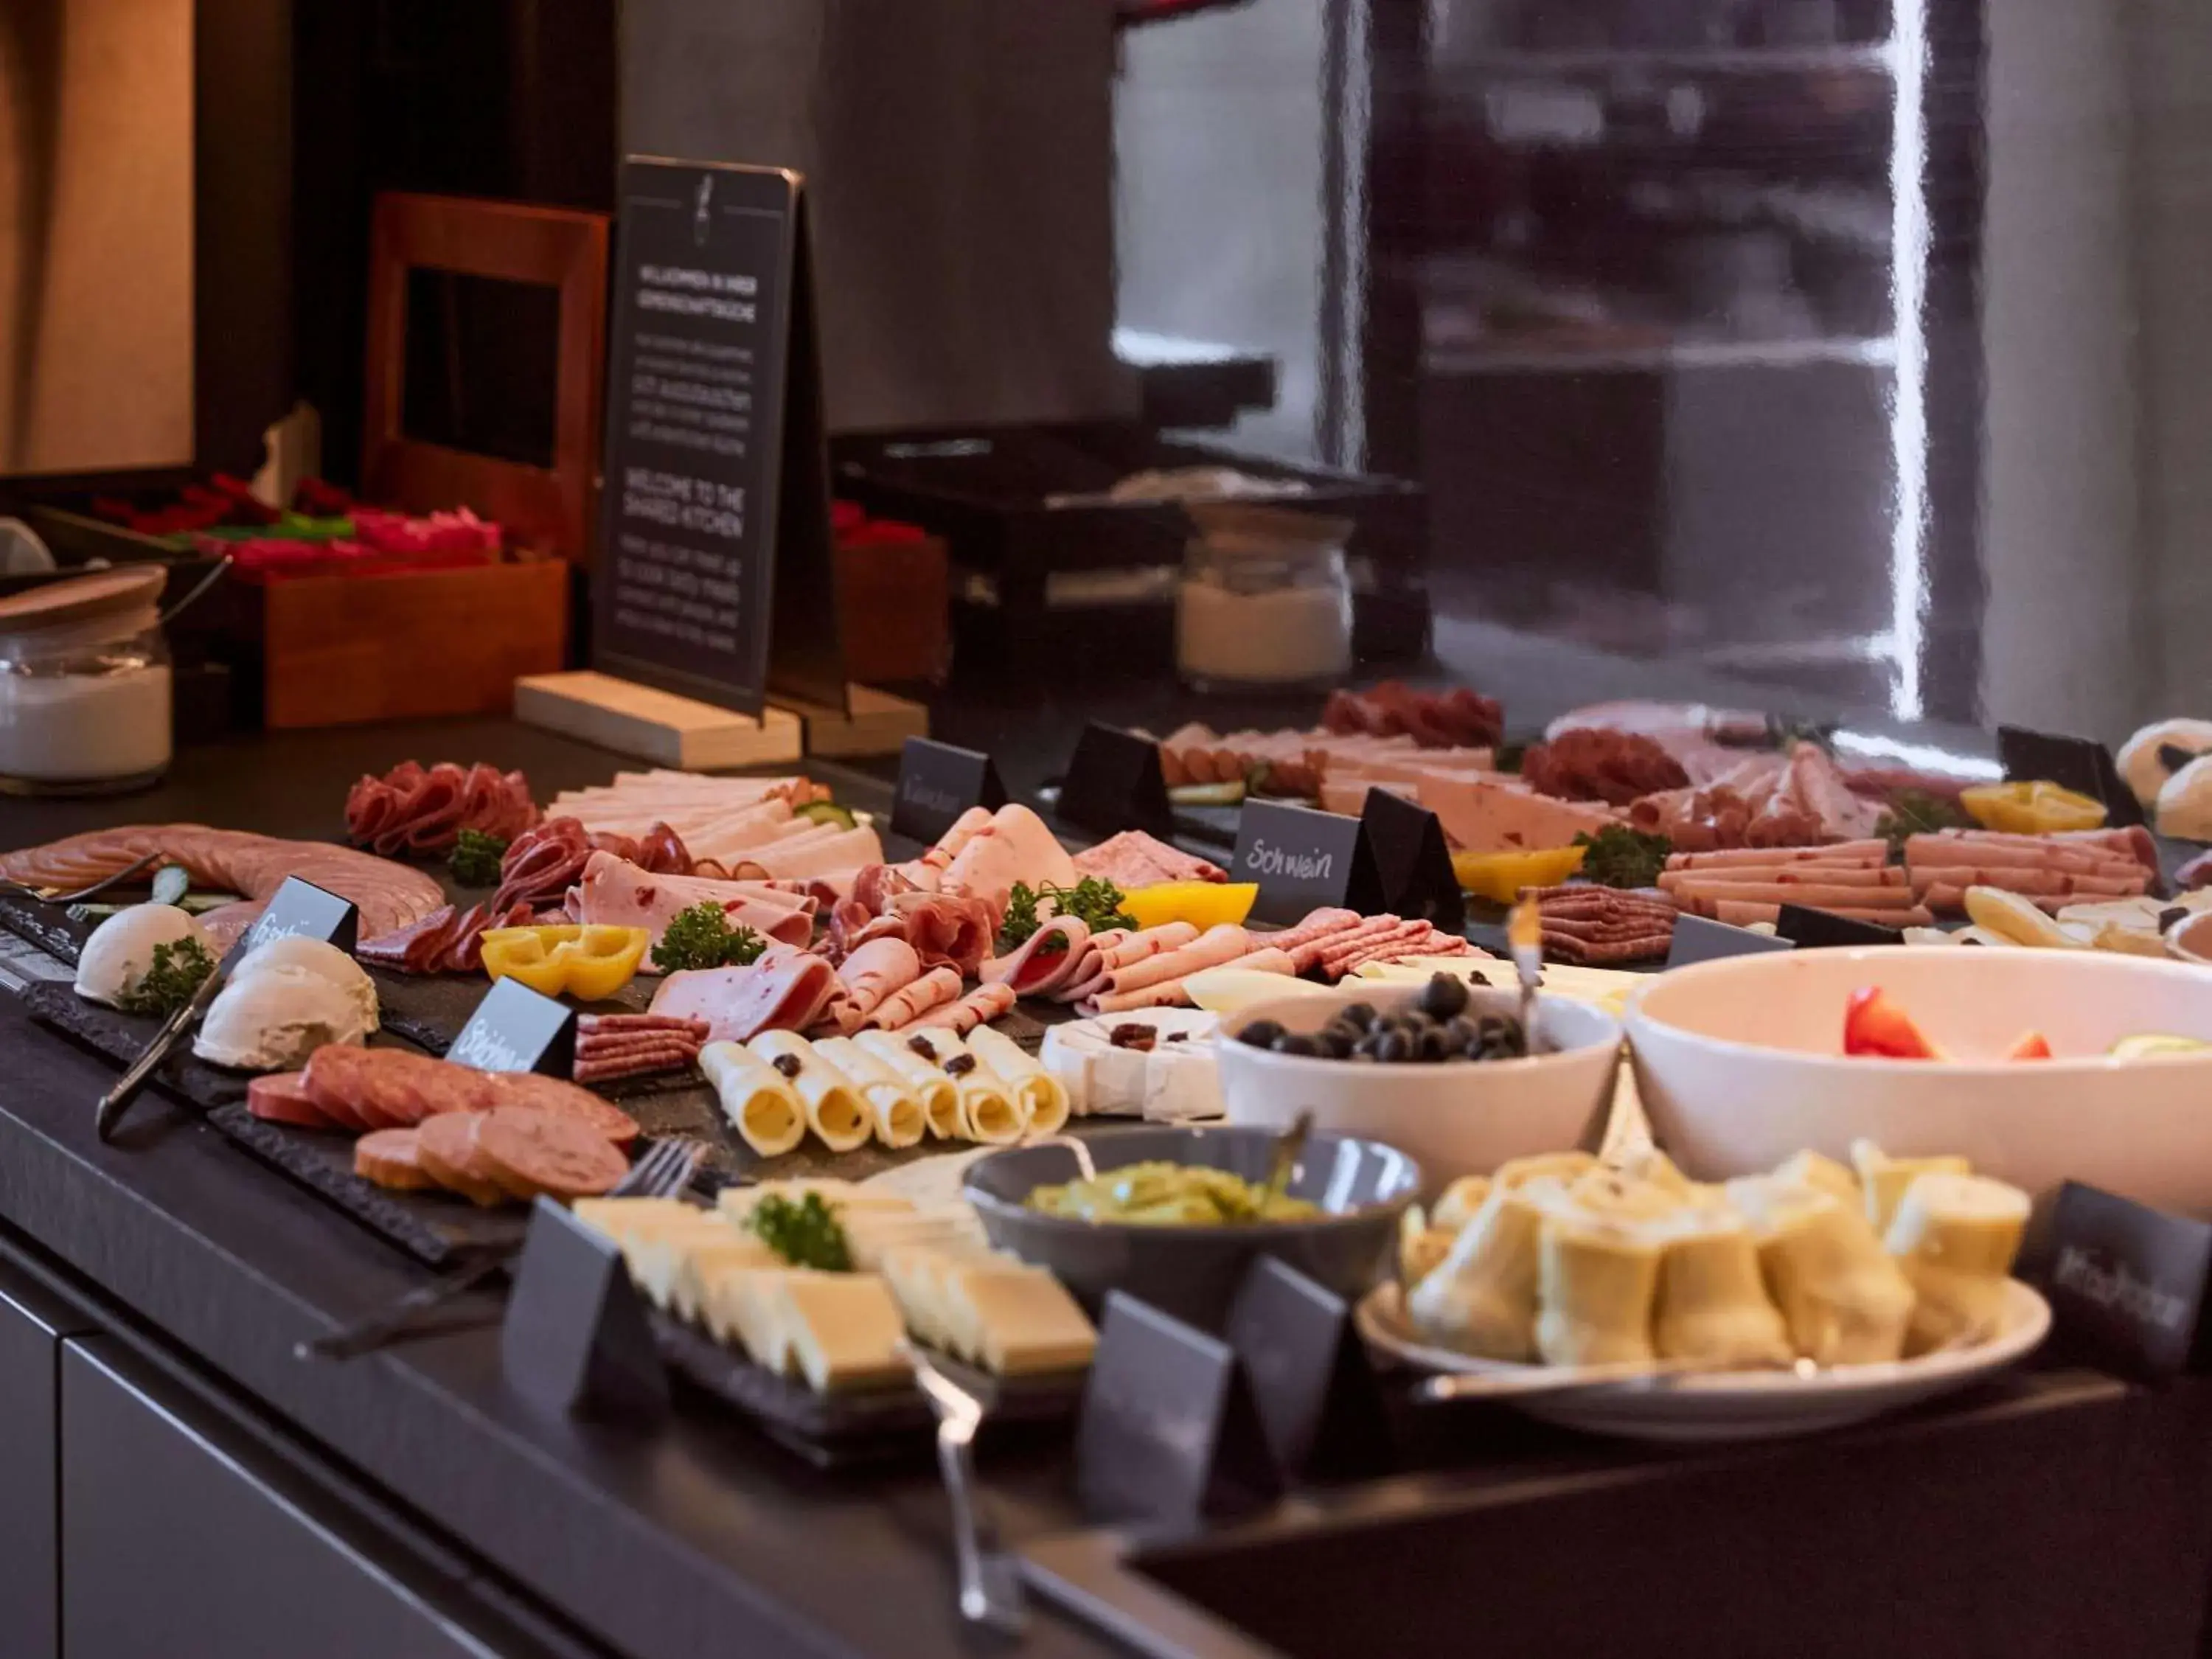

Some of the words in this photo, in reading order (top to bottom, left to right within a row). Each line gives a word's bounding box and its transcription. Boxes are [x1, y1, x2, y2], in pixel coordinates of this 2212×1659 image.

[626, 467, 692, 502] WELCOME
[695, 478, 715, 507] TO
[717, 483, 745, 512] THE
[682, 505, 742, 538] KITCHEN
